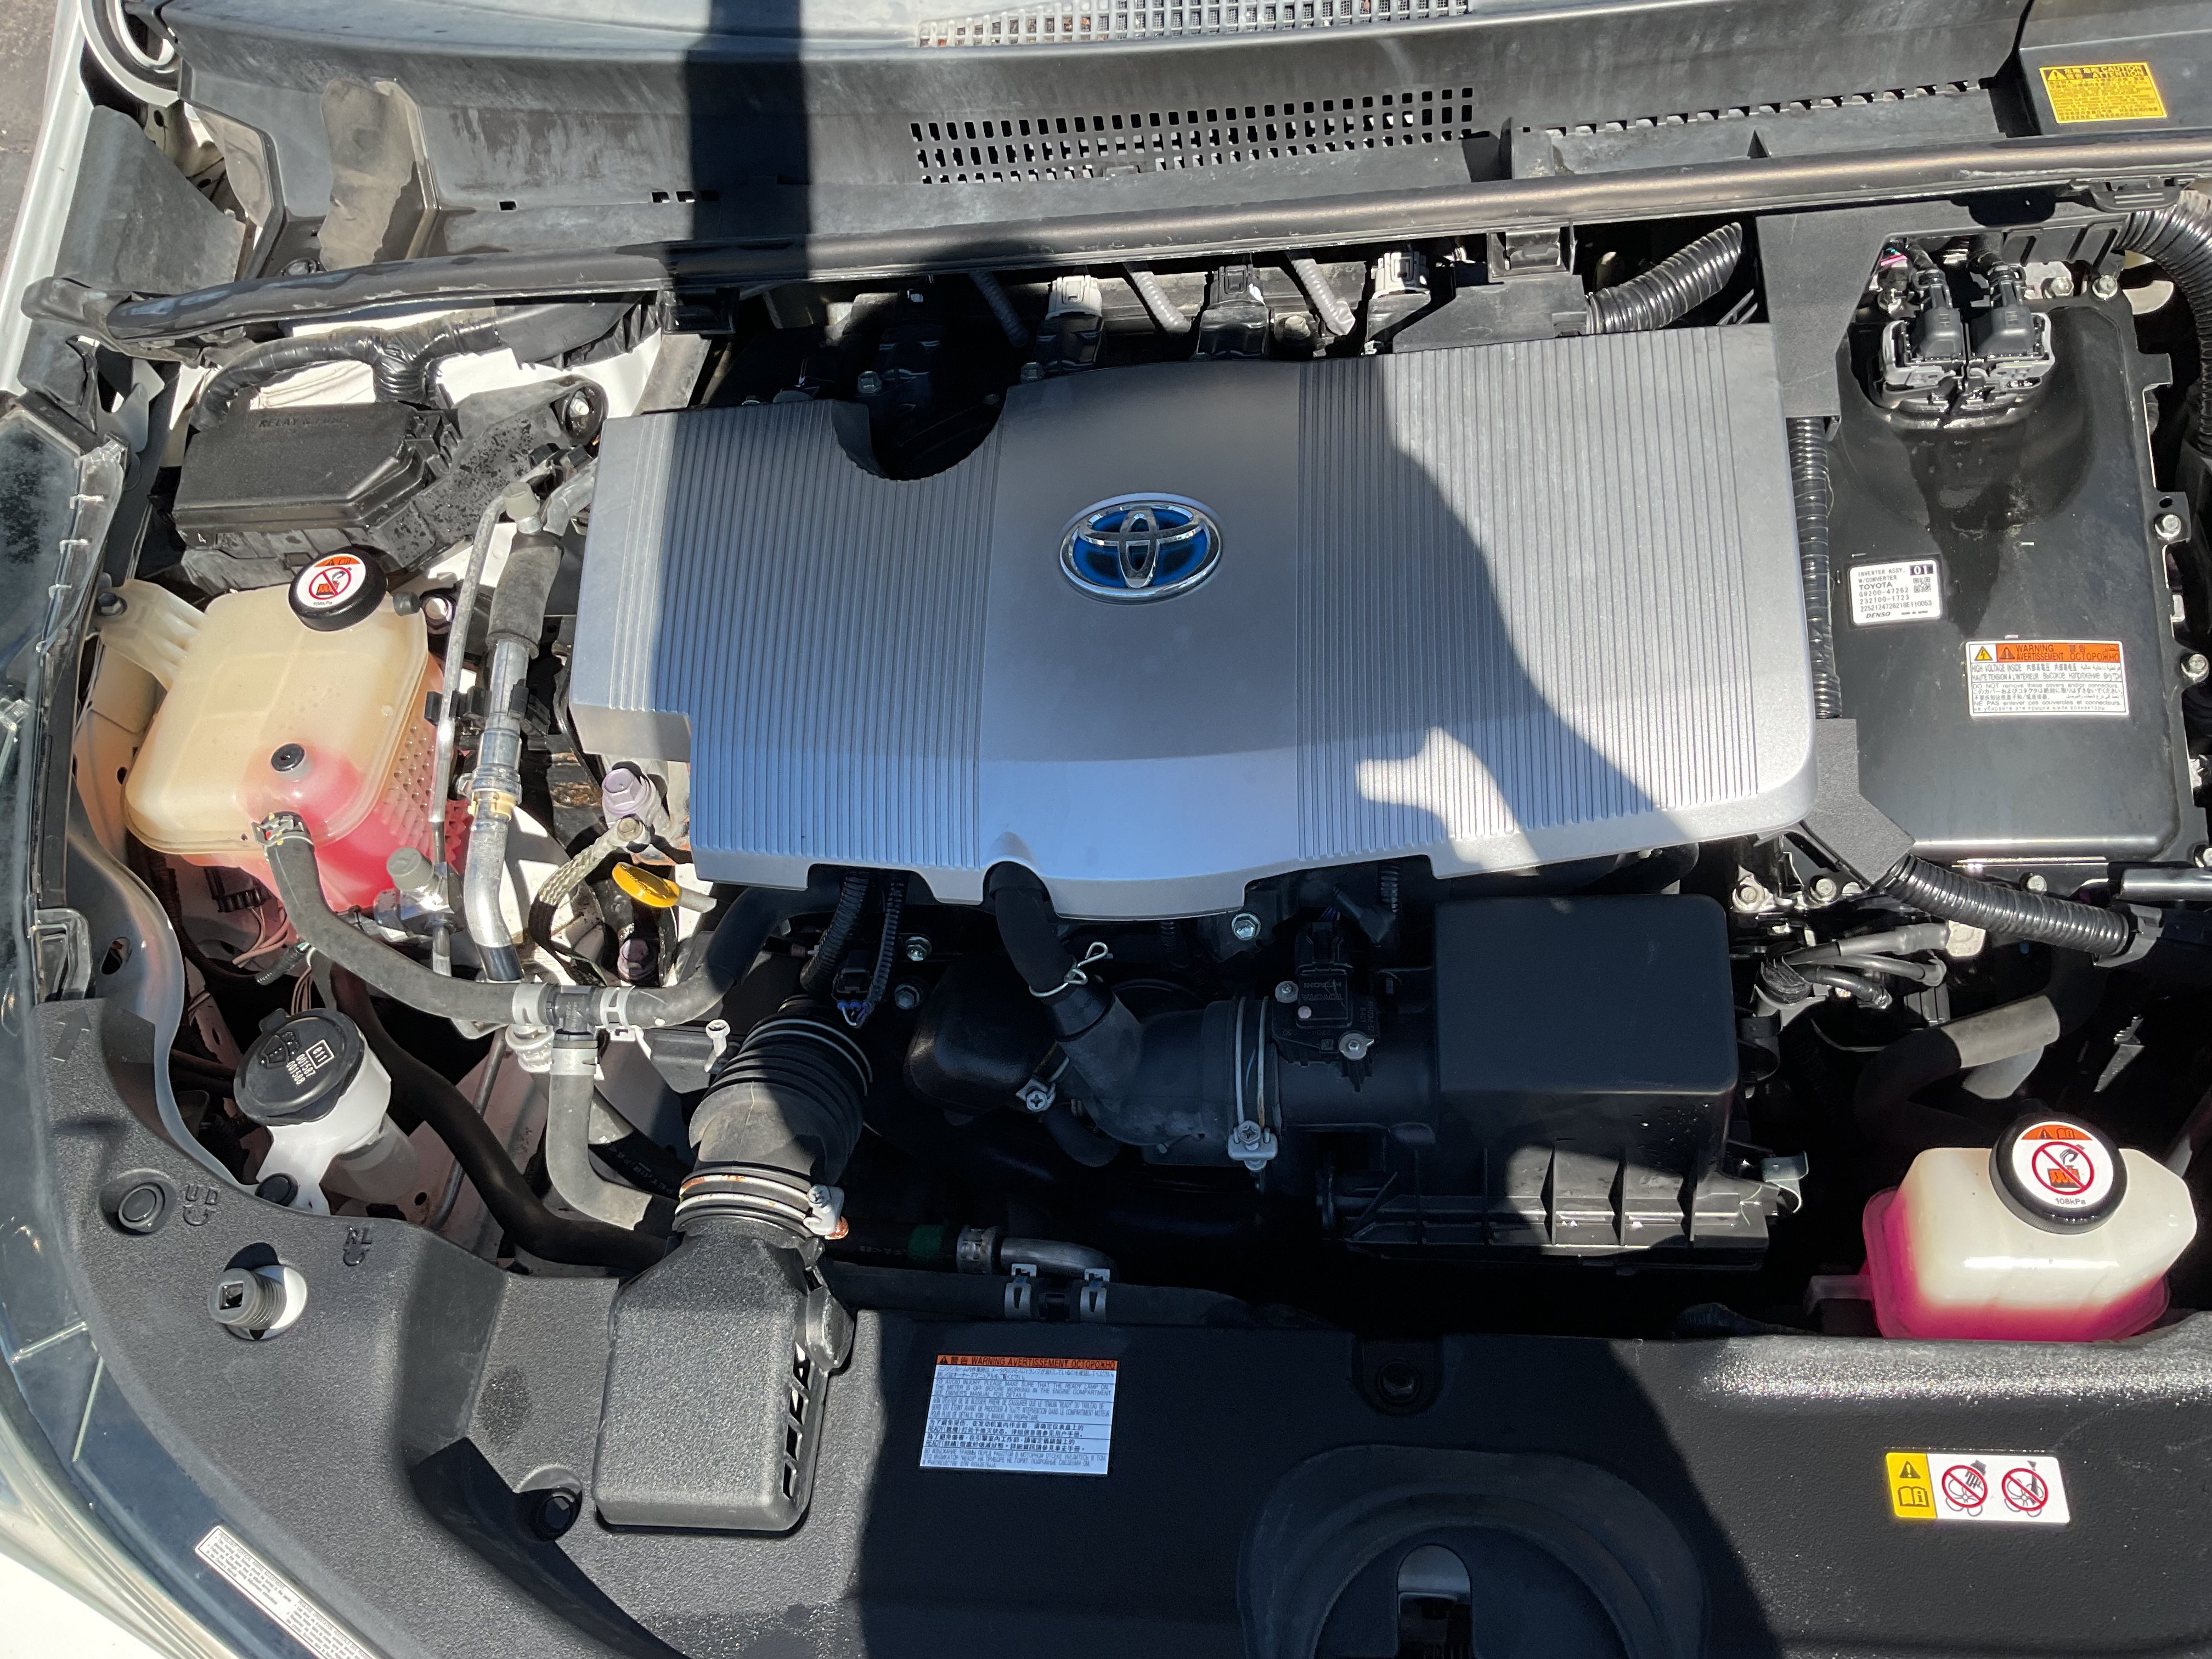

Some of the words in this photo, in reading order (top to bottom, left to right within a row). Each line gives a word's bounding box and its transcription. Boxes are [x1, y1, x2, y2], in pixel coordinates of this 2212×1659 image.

[2091, 70, 2145, 78] ATTENTION
[1914, 565, 1927, 575] 01
[1858, 574, 1897, 583] W/CONVERTER
[1859, 582, 1892, 590] TOYOTA
[1859, 586, 1908, 597] G9200-47262
[1859, 594, 1909, 604] 232100-1723
[1301, 992, 1344, 1001] TOYOTA
[296, 1053, 316, 1077] 001587
[286, 1060, 306, 1085] 001588
[972, 1357, 1005, 1365] WARNING
[1007, 1358, 1068, 1367] AVERTISSEMENT
[1071, 1360, 1115, 1369] ОСТОРОЖНО
